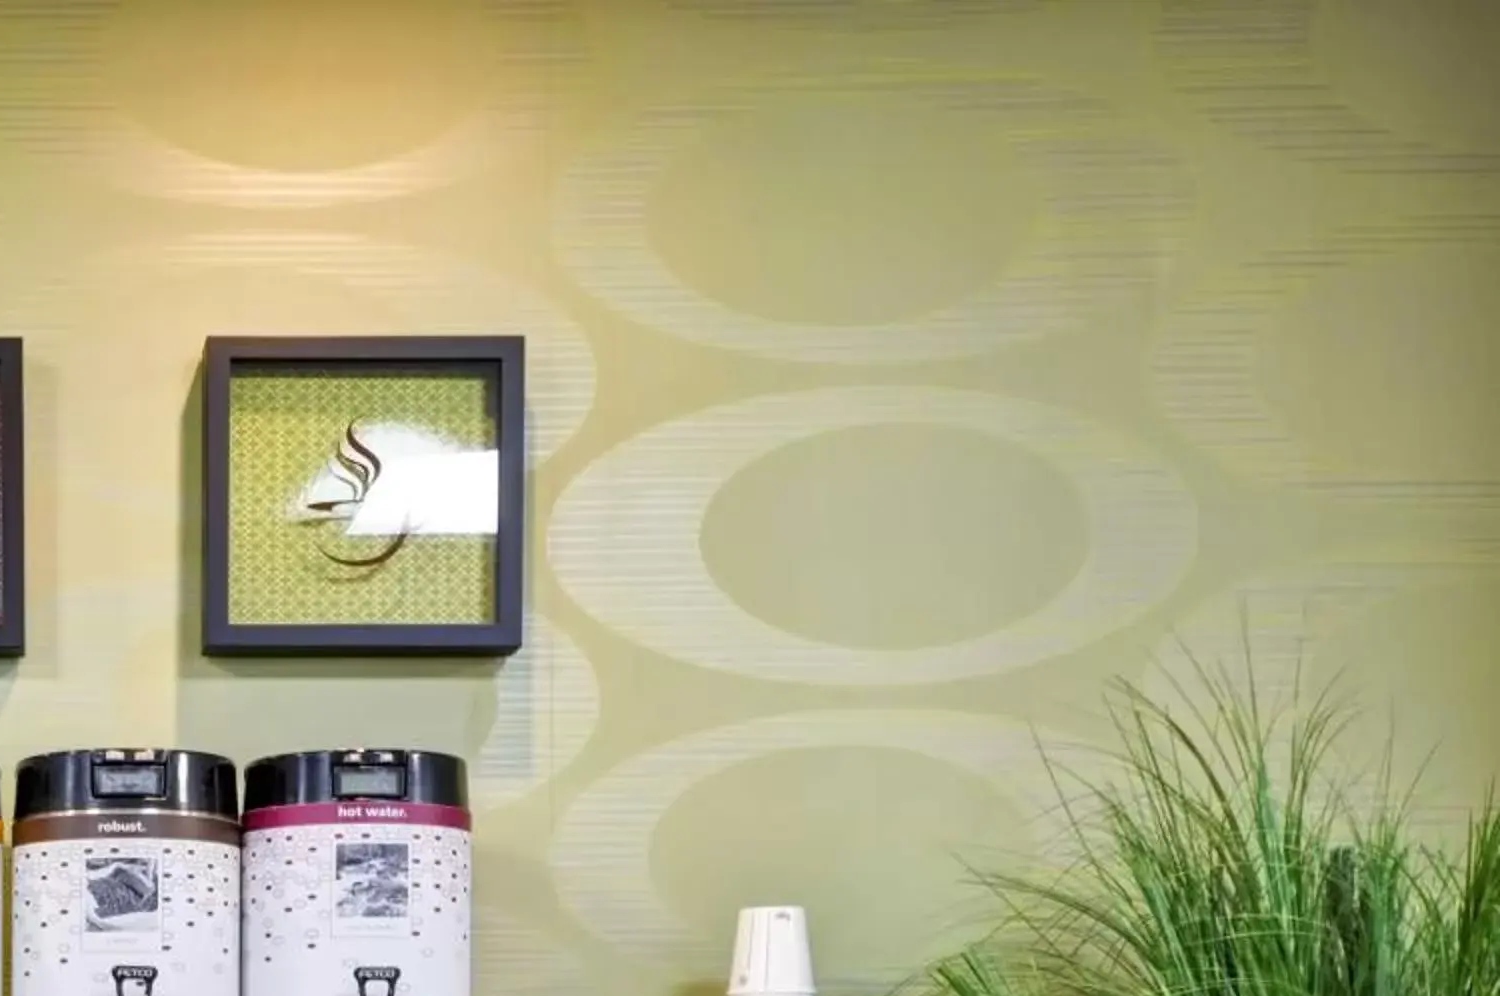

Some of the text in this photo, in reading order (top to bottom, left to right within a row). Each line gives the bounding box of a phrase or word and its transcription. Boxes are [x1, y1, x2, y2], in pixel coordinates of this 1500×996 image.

[337, 805, 408, 818] hot water.
[97, 820, 147, 833] robust.
